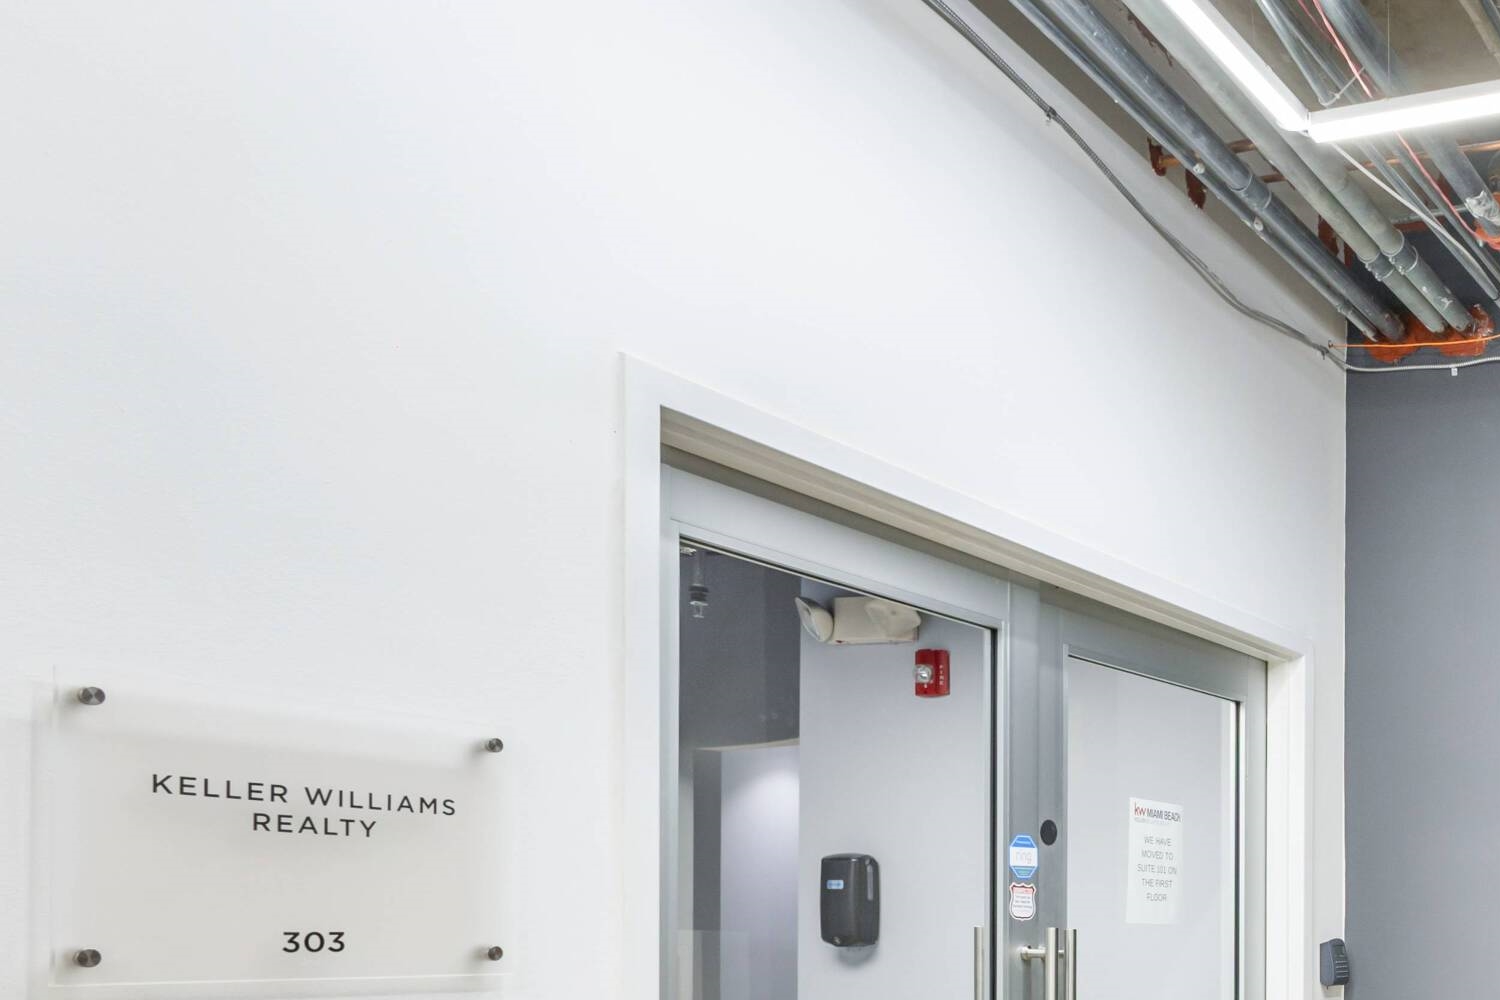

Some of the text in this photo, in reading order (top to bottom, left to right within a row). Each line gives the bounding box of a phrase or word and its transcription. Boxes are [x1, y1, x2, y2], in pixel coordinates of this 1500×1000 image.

[152, 773, 457, 816] KELLER WILLIAMS
[1147, 807, 1163, 819] MIAMI
[252, 812, 378, 838] REALTY
[1144, 836, 1172, 847] WE HAVE
[1141, 850, 1174, 861] MOVED TO
[1137, 863, 1155, 873] SUITE
[1167, 866, 1177, 875] ON
[1141, 878, 1172, 888] THE FIRST
[1146, 892, 1167, 902] FLOOR
[282, 931, 346, 955] 303
